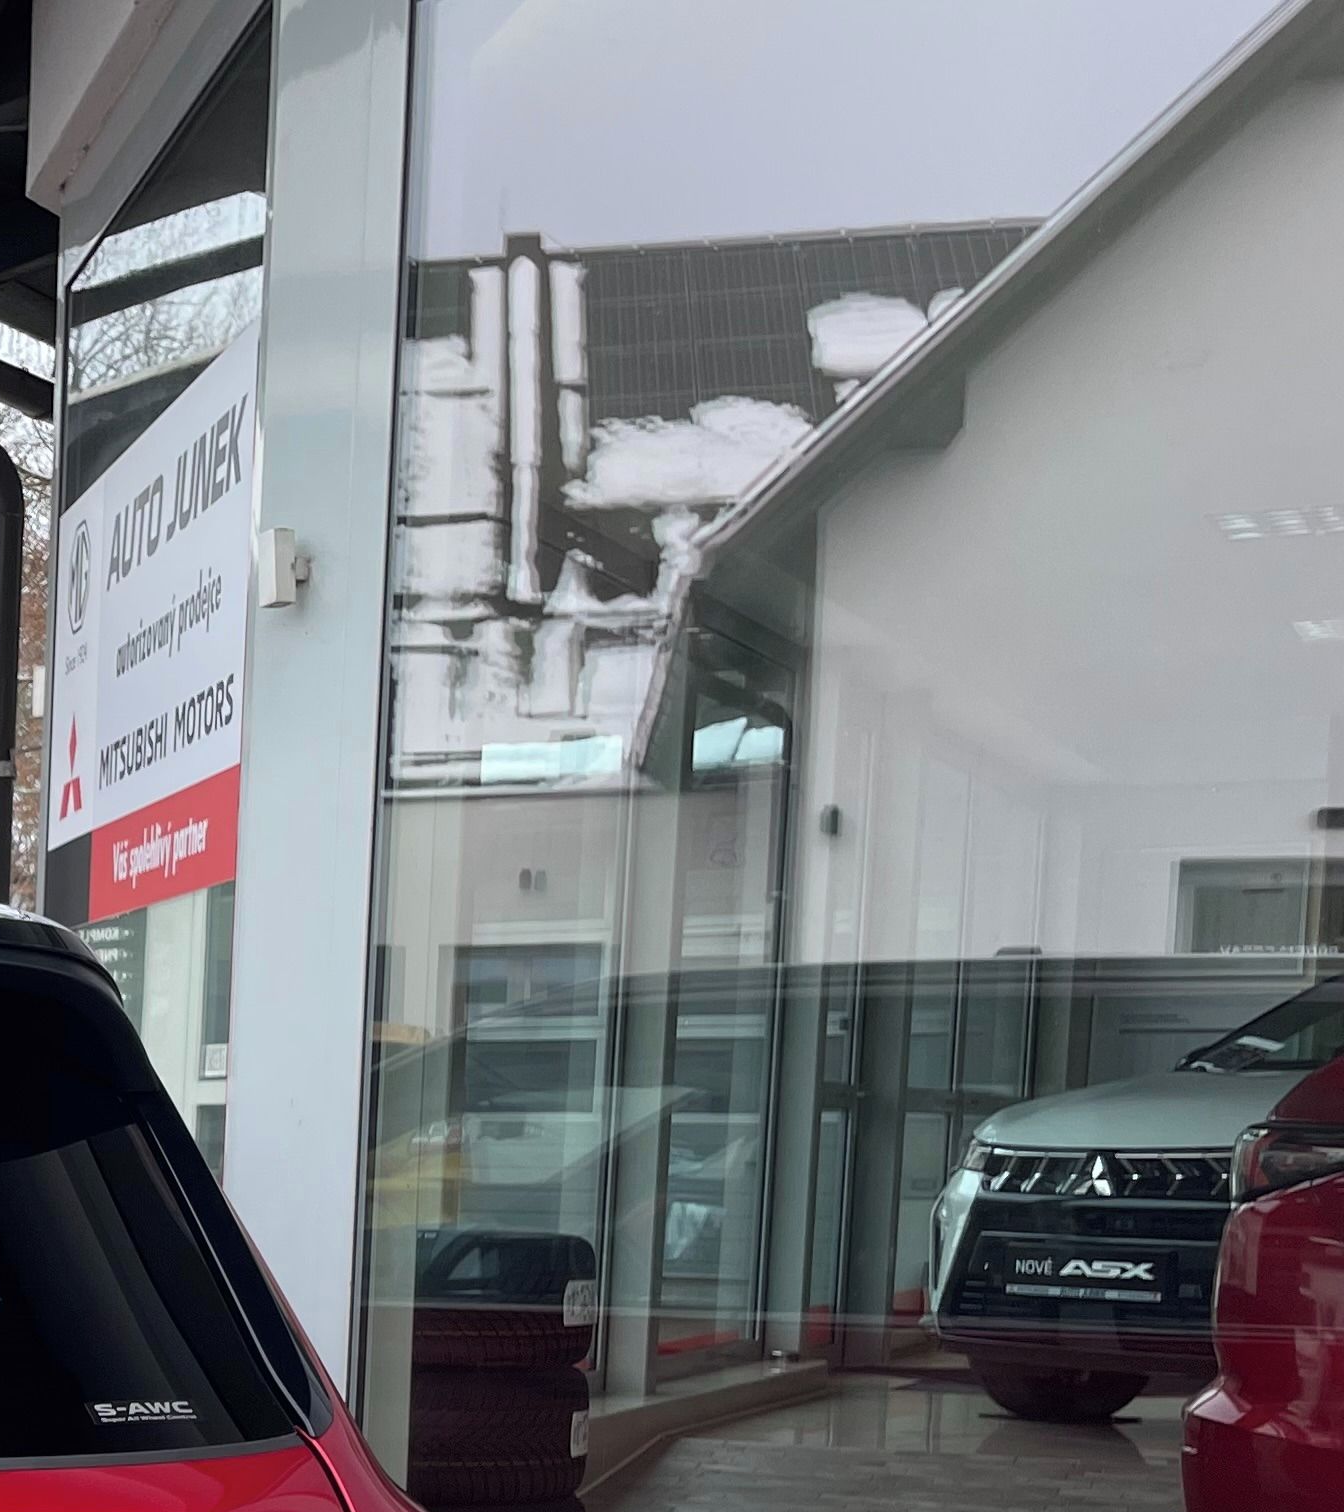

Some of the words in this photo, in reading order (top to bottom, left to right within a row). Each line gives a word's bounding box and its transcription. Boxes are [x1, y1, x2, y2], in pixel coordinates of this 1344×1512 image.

[106, 473, 164, 592] AUTO
[165, 392, 249, 543] JUNEK
[115, 594, 177, 678] autorizovaný
[177, 566, 222, 652] prodejce
[98, 712, 169, 790] MITSUBISHI
[173, 672, 235, 753] MOTORS
[112, 838, 129, 884] Váš
[172, 818, 209, 877] partner
[1015, 1256, 1053, 1276] NOVÉ
[1058, 1258, 1155, 1281] ASX
[93, 1400, 194, 1417] S-AWC
